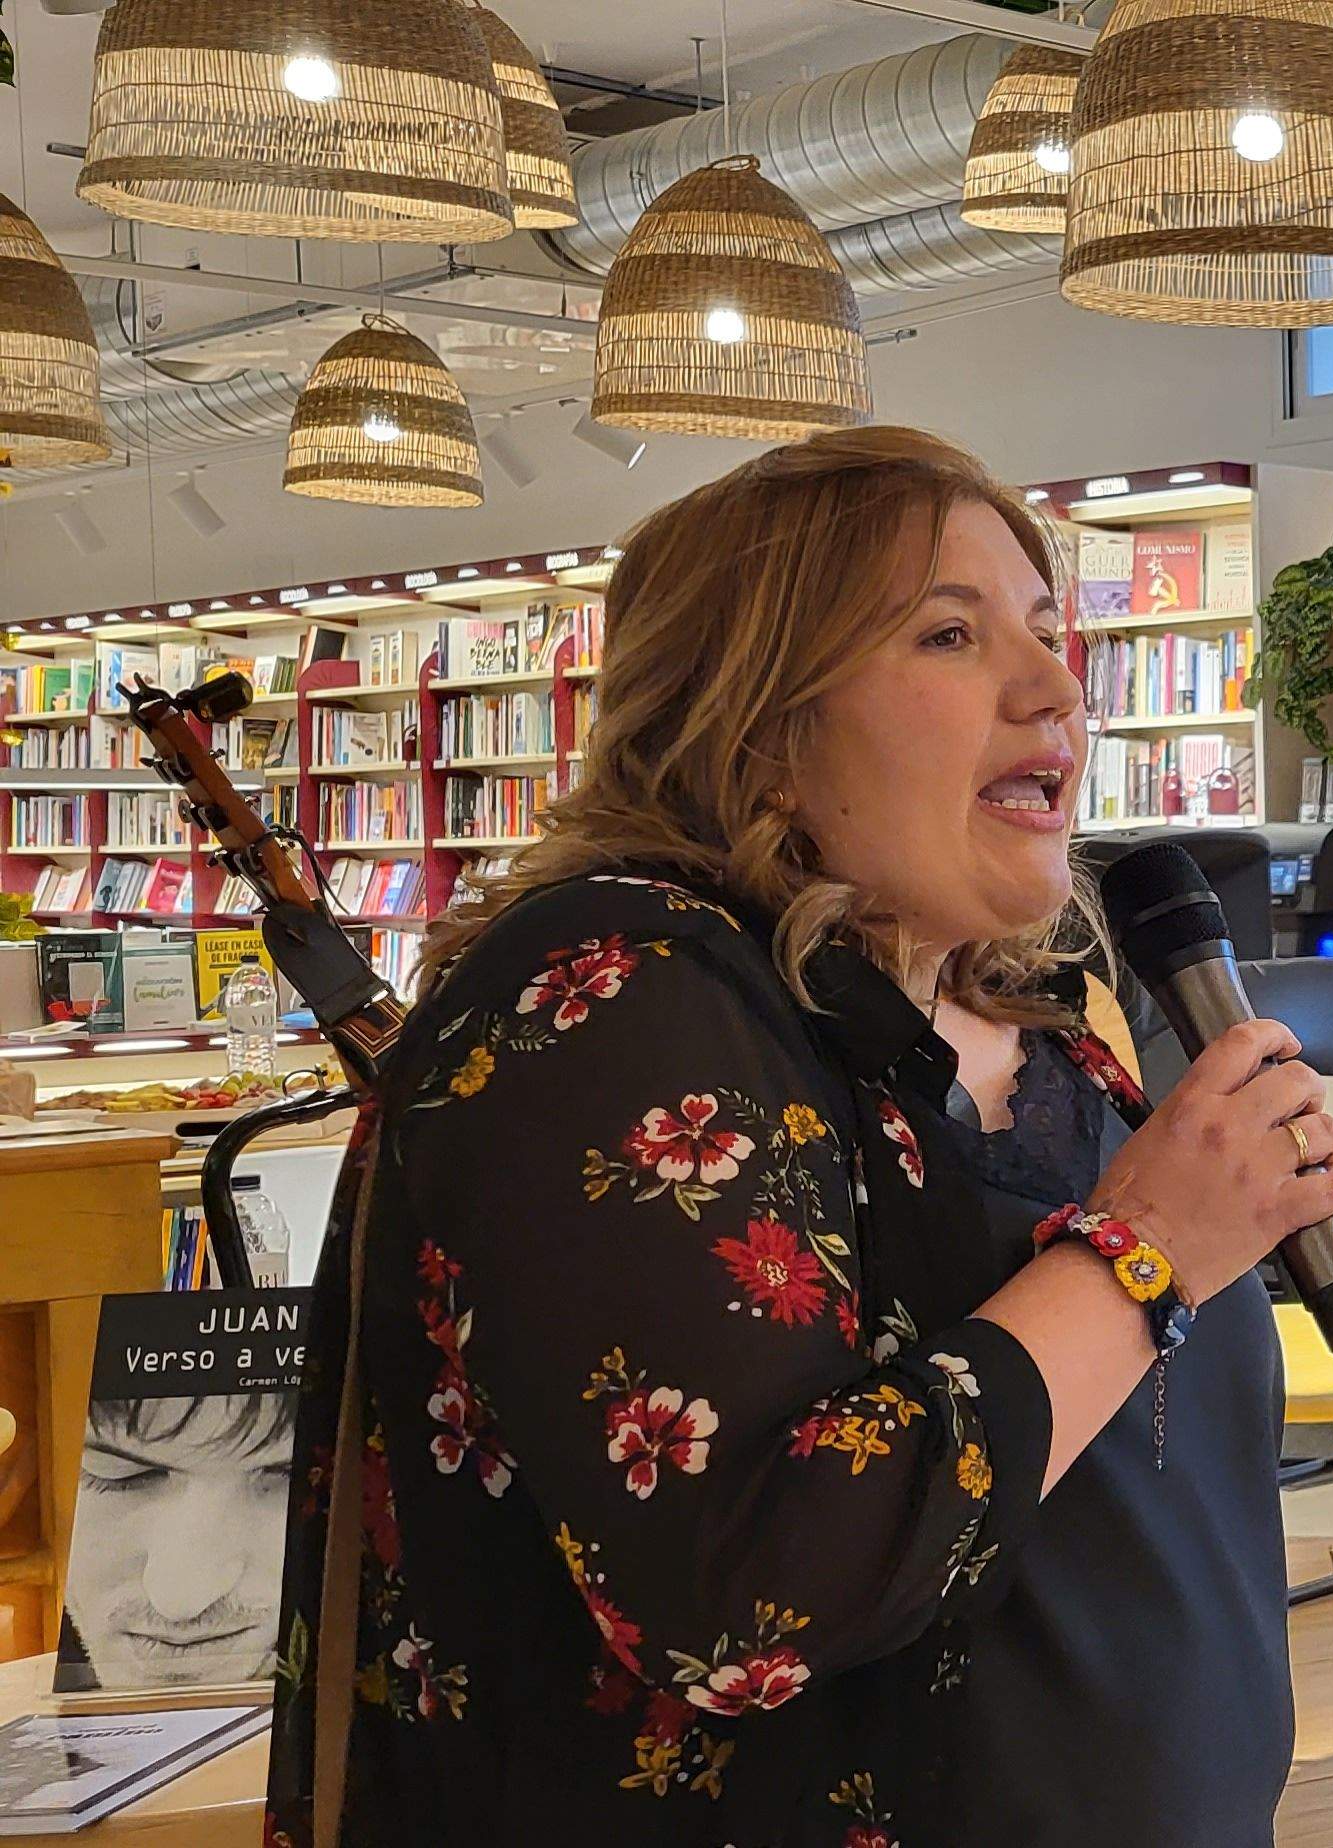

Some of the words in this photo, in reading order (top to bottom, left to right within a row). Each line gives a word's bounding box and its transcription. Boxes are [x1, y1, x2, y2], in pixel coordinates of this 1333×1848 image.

[1137, 544, 1196, 555] COMUNISMO
[199, 1305, 299, 1334] JUAN
[126, 1346, 215, 1374] Verso
[236, 1348, 252, 1368] a
[239, 1377, 278, 1387] Carmen
